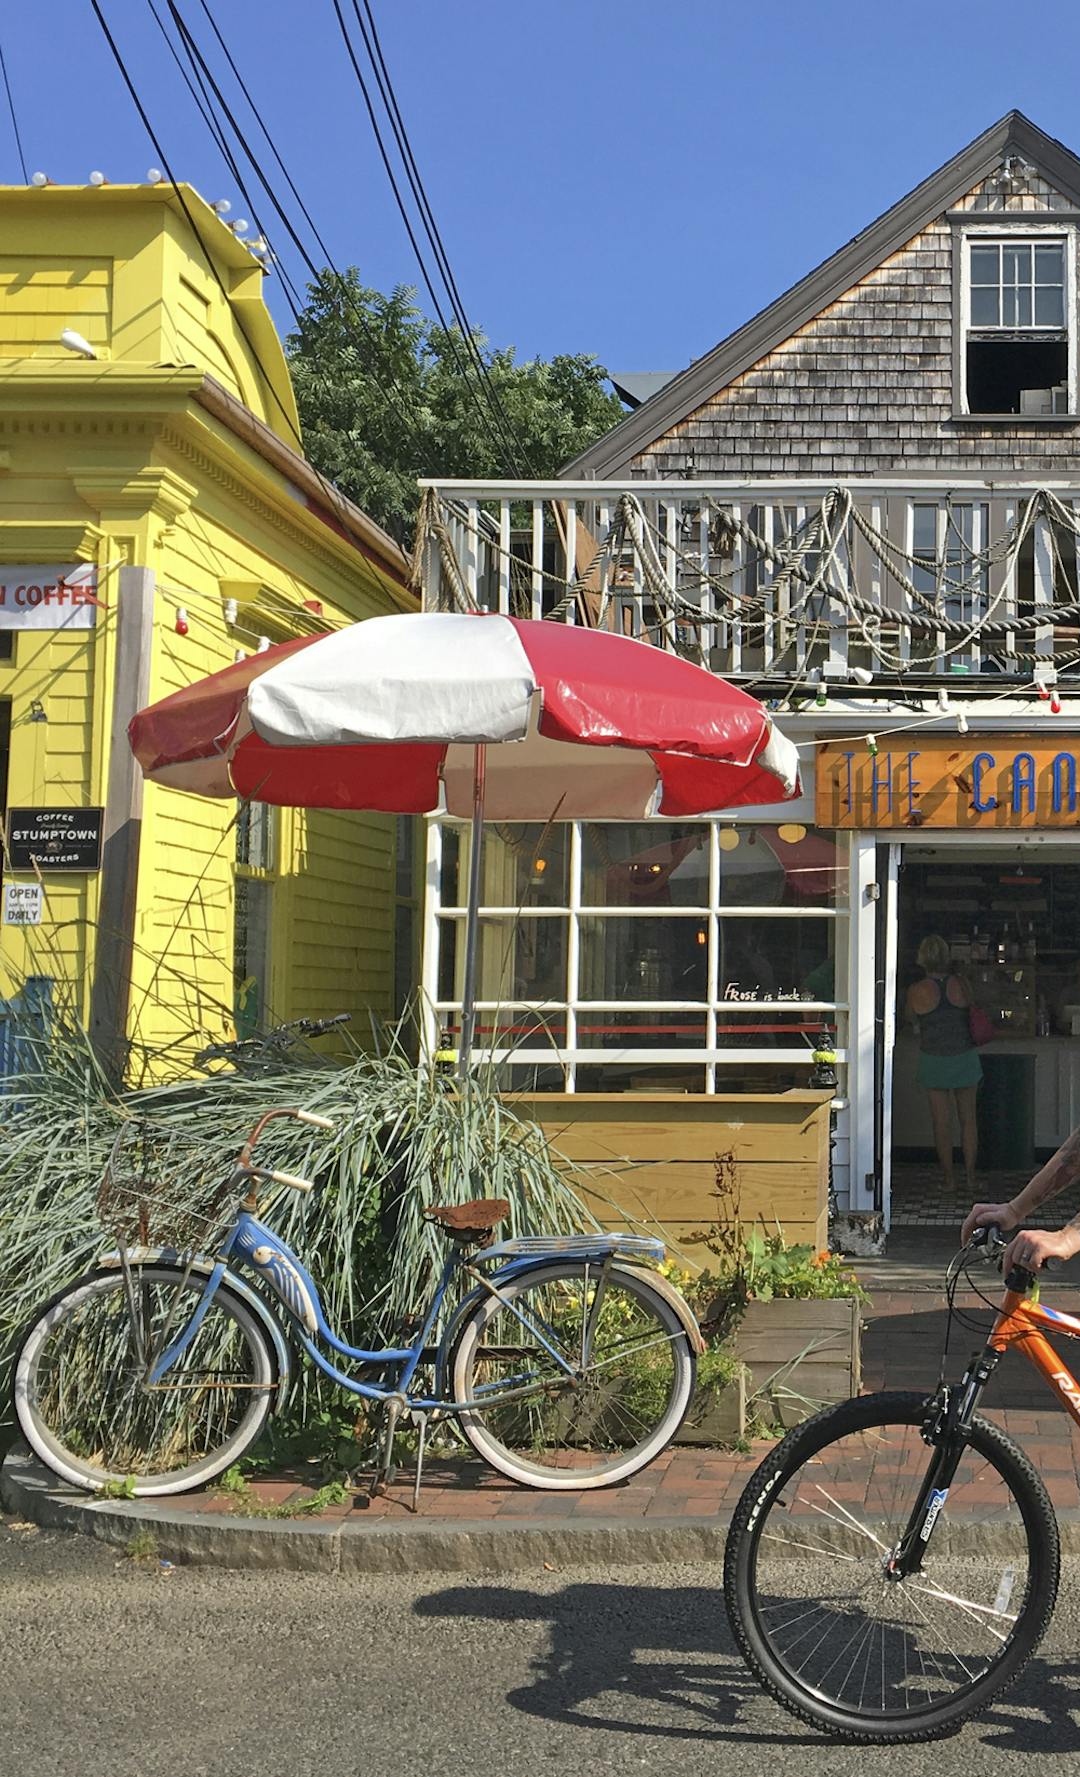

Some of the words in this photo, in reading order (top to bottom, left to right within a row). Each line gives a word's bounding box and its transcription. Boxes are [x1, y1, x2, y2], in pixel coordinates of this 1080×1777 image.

[14, 584, 97, 606] COFFEE
[842, 751, 922, 814] THE
[35, 813, 74, 822] COFFEE
[12, 830, 97, 840] STUMPTOWN
[9, 888, 38, 899] OPEN
